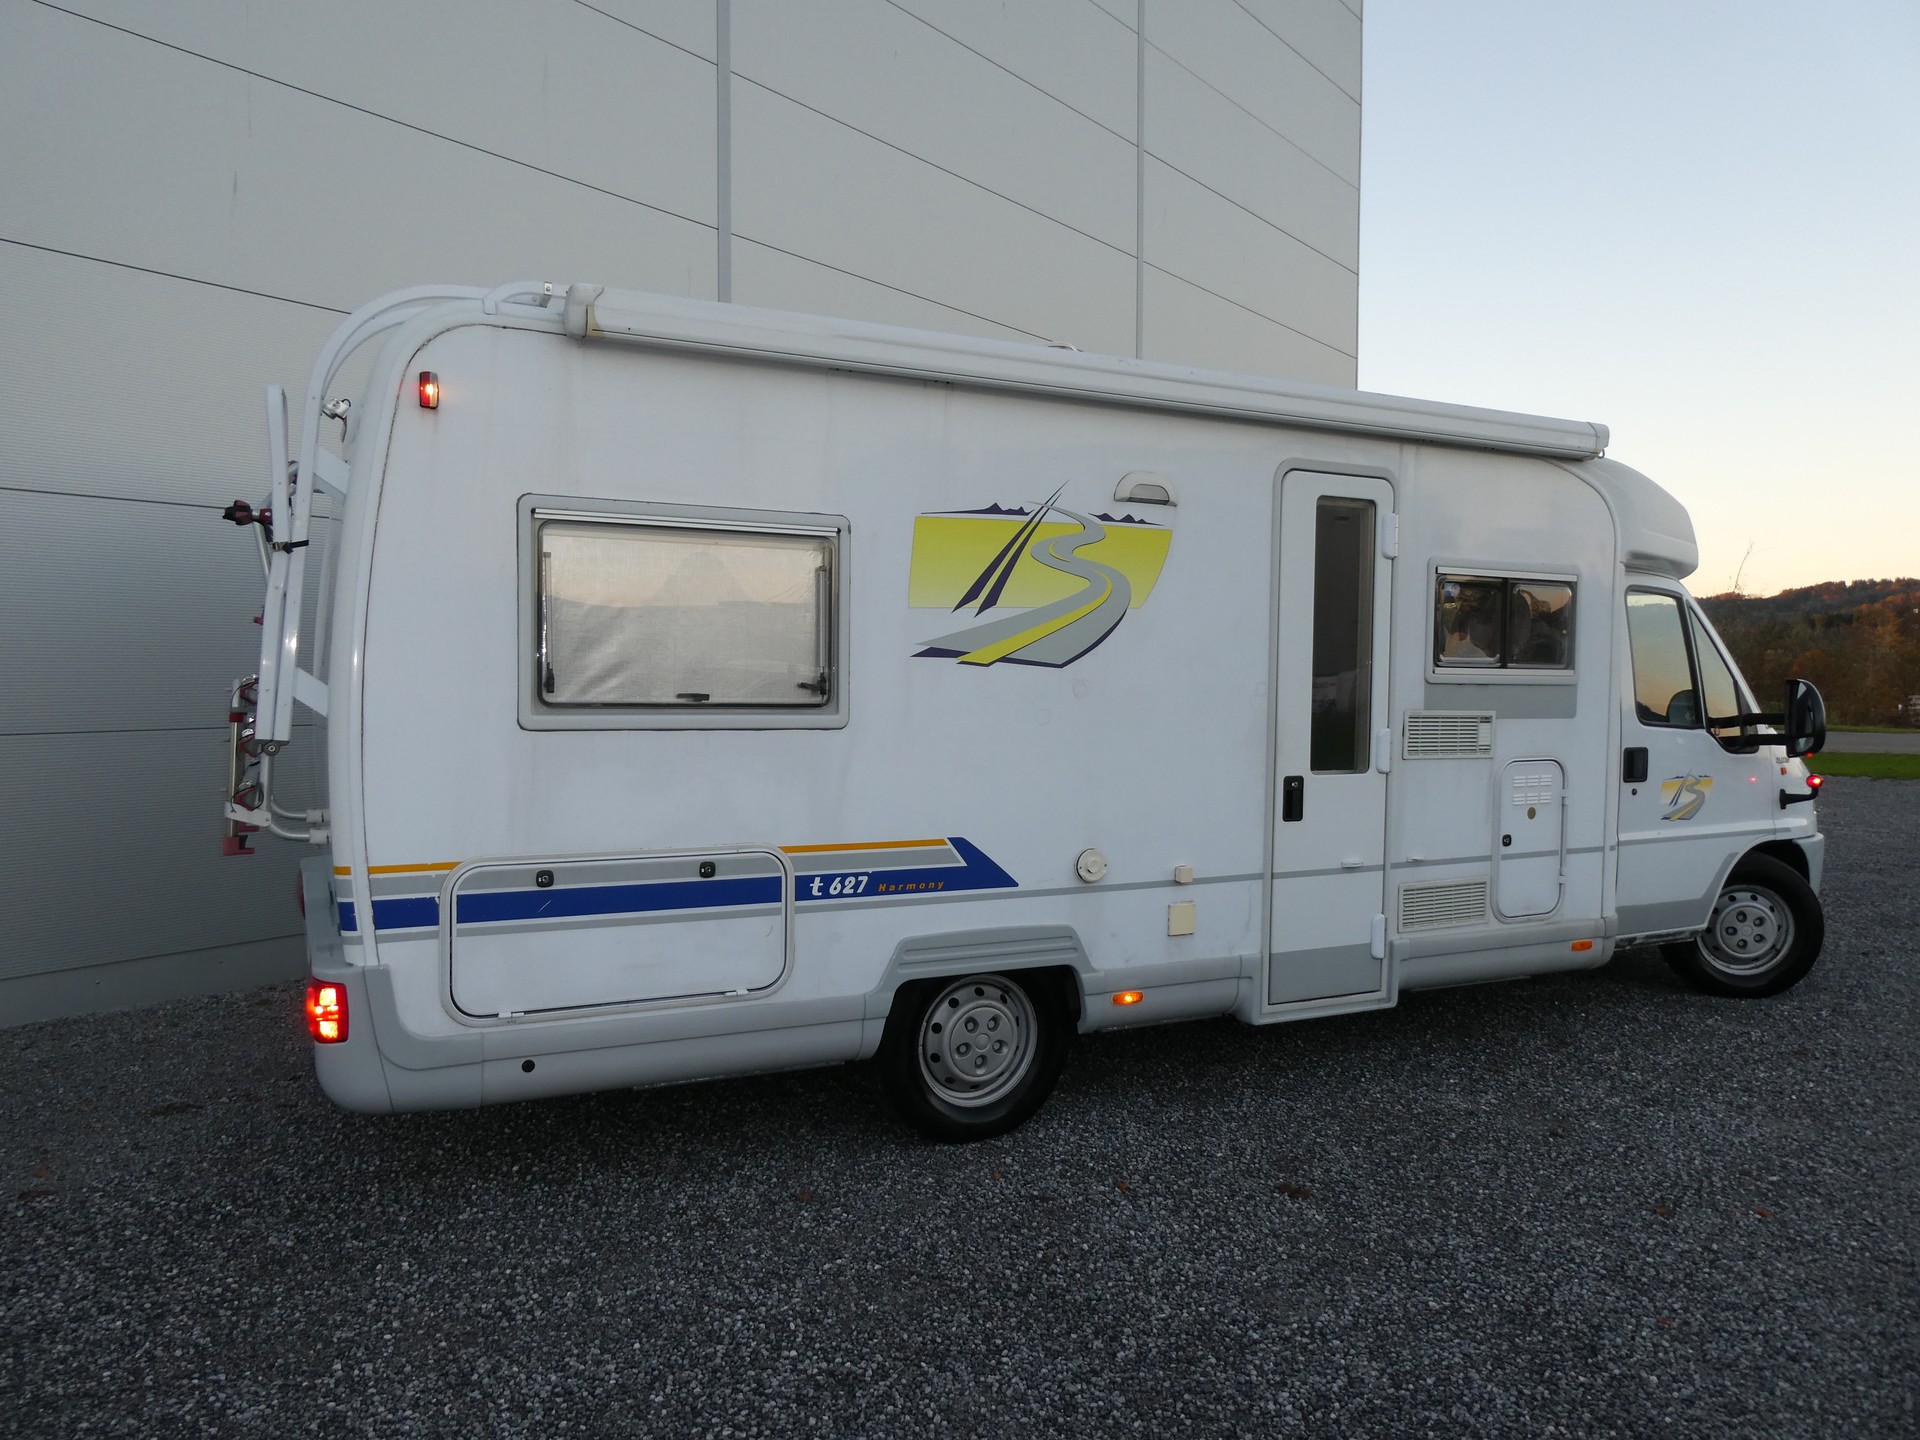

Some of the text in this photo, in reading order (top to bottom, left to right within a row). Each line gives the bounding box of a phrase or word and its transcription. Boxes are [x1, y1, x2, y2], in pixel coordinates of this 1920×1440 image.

[809, 875, 945, 896] t 627 Harmony
